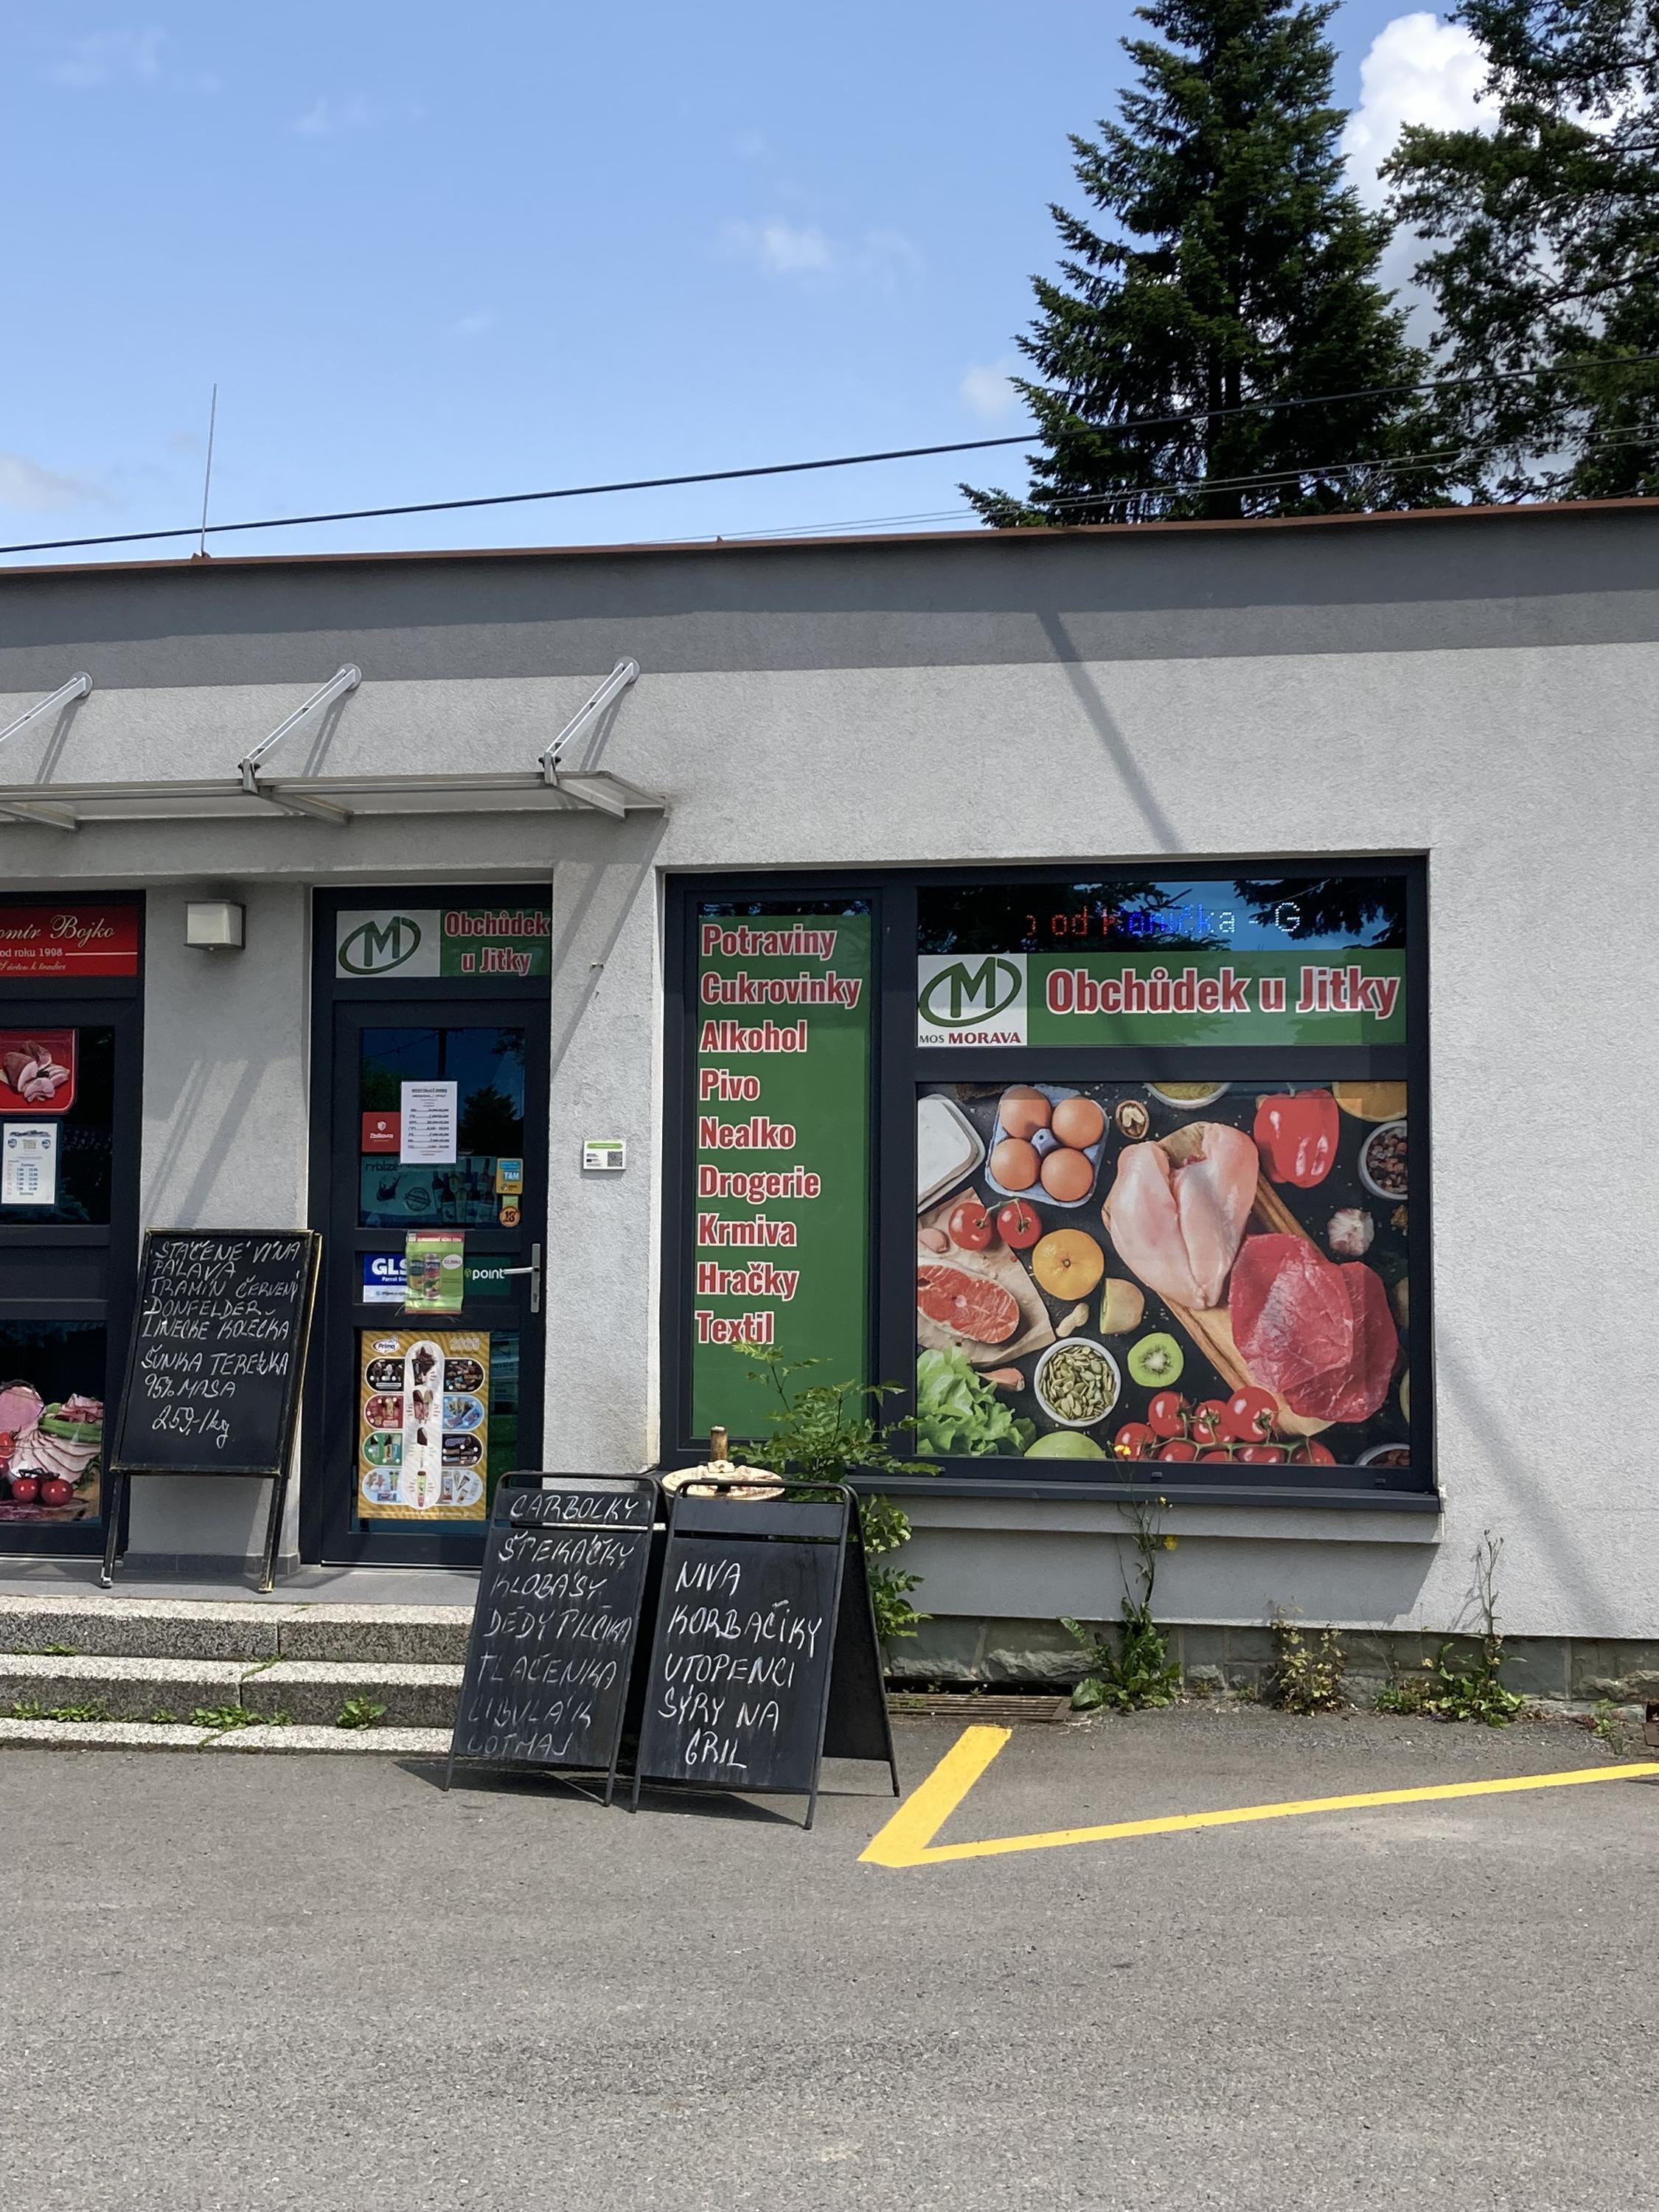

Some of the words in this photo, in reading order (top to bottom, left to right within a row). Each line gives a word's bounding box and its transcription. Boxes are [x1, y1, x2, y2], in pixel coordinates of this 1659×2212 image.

[50, 914, 116, 947] Bojko
[445, 911, 551, 937] Obchůdek
[1275, 902, 1301, 932] G
[15, 947, 35, 957] roku
[702, 923, 838, 961] Potraviny
[461, 952, 476, 973] u
[481, 947, 532, 975] Jitky
[701, 971, 862, 1009] Cukrovinky
[1046, 967, 1251, 1014] Obchůdek
[1259, 977, 1287, 1012] u
[1295, 965, 1401, 1020] Jitky
[700, 1020, 807, 1052] Alkohol
[919, 1034, 945, 1043] MOS
[948, 1032, 1021, 1044] MORAVA
[700, 1068, 760, 1101] Pivo
[699, 1116, 796, 1149] Nealko
[698, 1164, 821, 1204] Drogerie
[698, 1213, 797, 1246] Krmiva
[152, 1259, 237, 1281] PÁLAVA
[372, 1258, 407, 1276] GLS
[697, 1262, 799, 1301] Hračky
[695, 1310, 774, 1345] Textil
[141, 1344, 204, 1373] ŠUNKA
[145, 1374, 175, 1399] 95%
[176, 1378, 236, 1398] MASA
[490, 1569, 608, 1600] KLOBÁSY
[675, 1559, 741, 1596] NIVA
[665, 1653, 796, 1688] UTOPENCI
[658, 1684, 726, 1726] SÝRY
[737, 1700, 779, 1731] NA
[686, 1728, 747, 1769] GRIL
